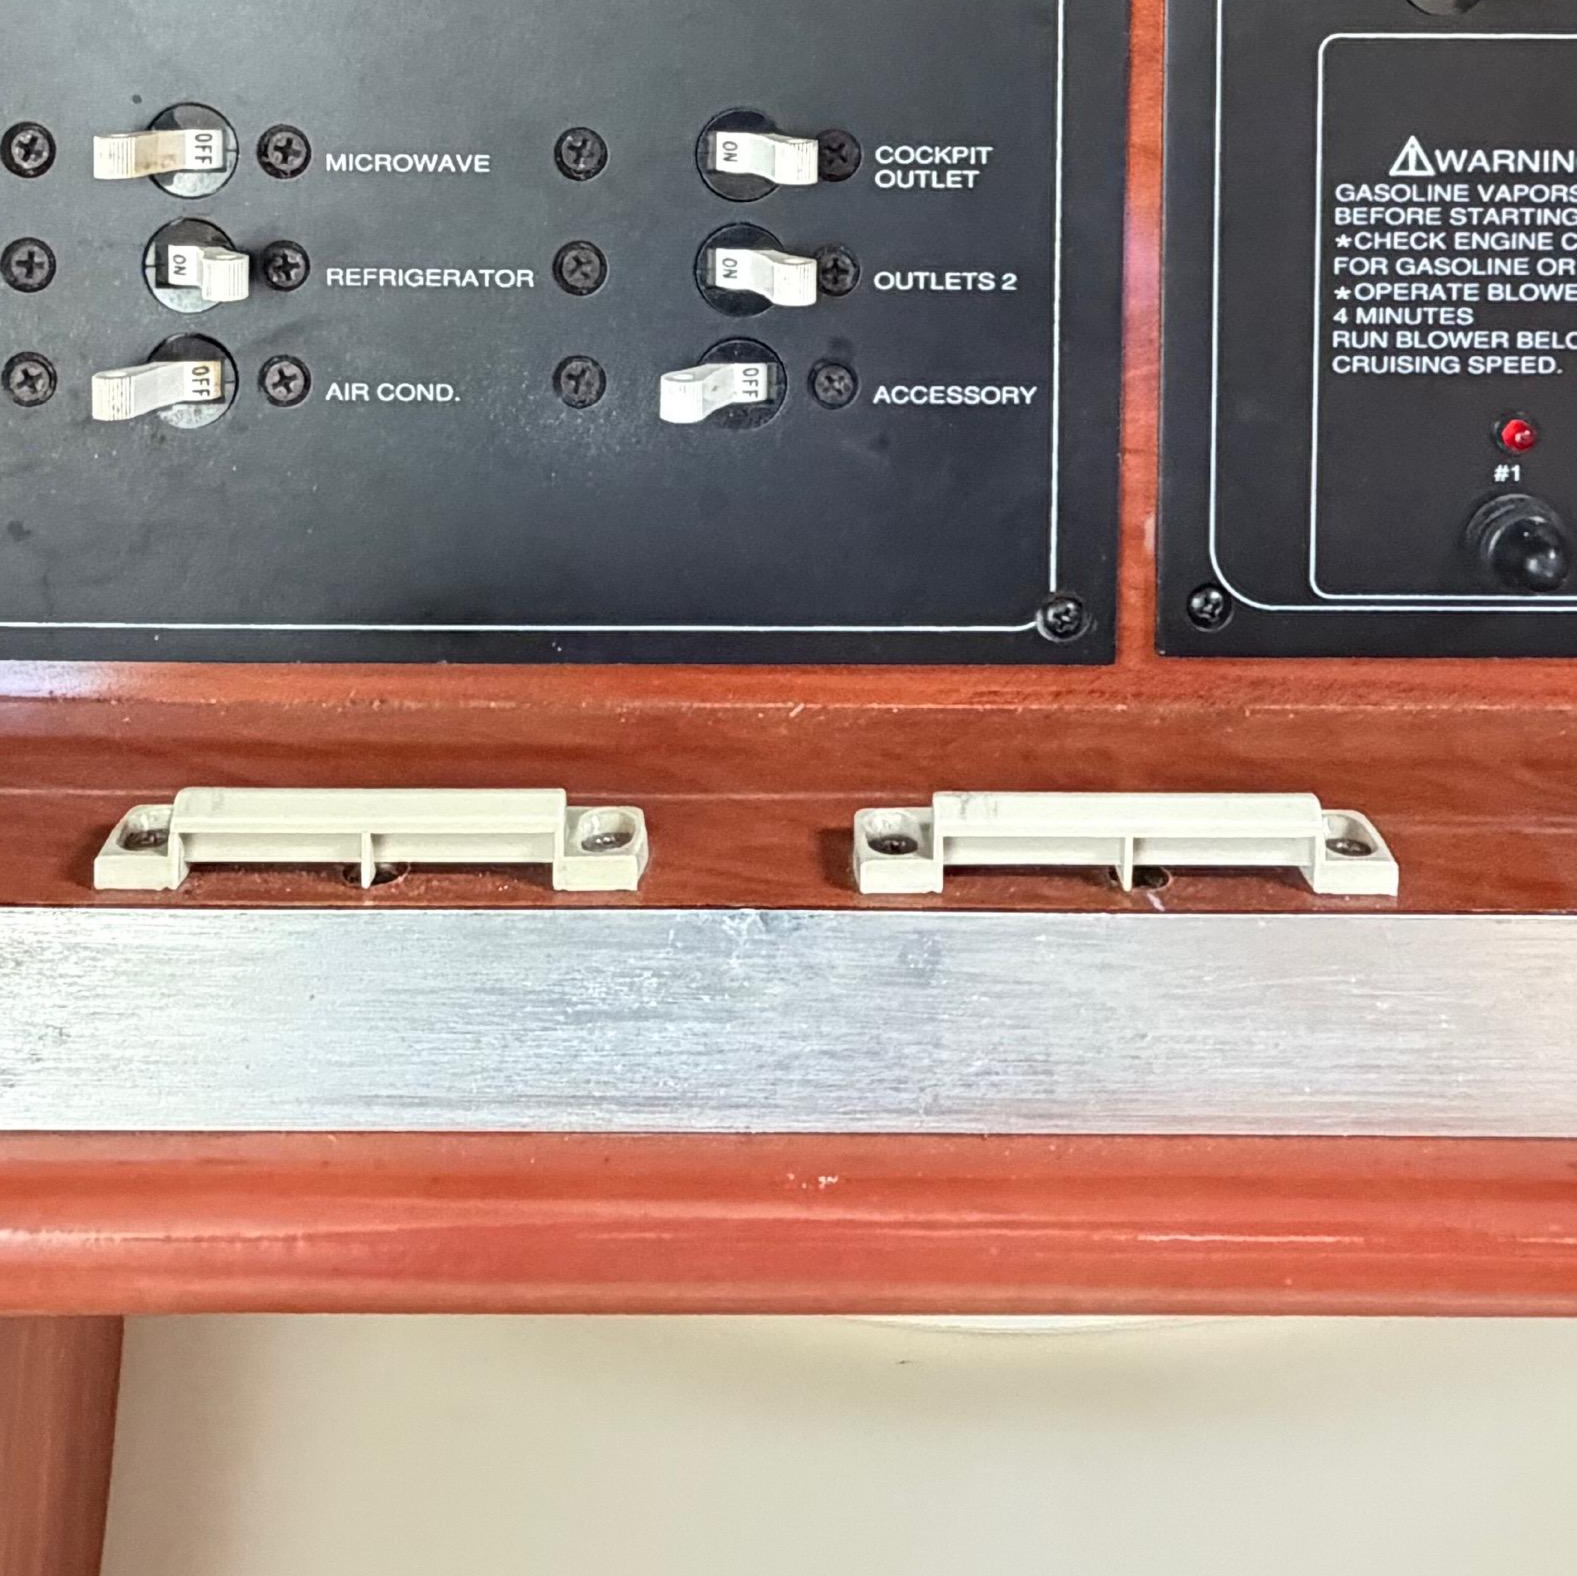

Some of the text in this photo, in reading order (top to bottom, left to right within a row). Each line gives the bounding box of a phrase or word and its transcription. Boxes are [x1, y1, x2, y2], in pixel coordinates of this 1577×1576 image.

[194, 133, 213, 164] OFF
[722, 140, 738, 162] ON
[874, 145, 994, 165] COCKPIT
[325, 153, 491, 173] MICROWAVE
[874, 169, 981, 189] OUTLET
[1334, 183, 1470, 203] GASOLINE
[1334, 206, 1442, 226] BEFORE
[1453, 231, 1554, 251] ENGINE
[1333, 256, 1389, 276] FOR
[1394, 256, 1531, 276] GASOLINE
[1536, 257, 1577, 276] OR
[325, 267, 535, 288] REFRIGERATOR
[872, 270, 1018, 291] OUTLETS 2
[1332, 306, 1475, 326] 4 MINUTES
[1332, 329, 1389, 349] RUN
[1395, 330, 1510, 349] BLOWER
[1331, 354, 1563, 374] CRUISING SPEED.
[324, 382, 461, 402] AIR COND.
[872, 385, 1038, 405] ACCESSORY
[1493, 464, 1521, 482] #1
